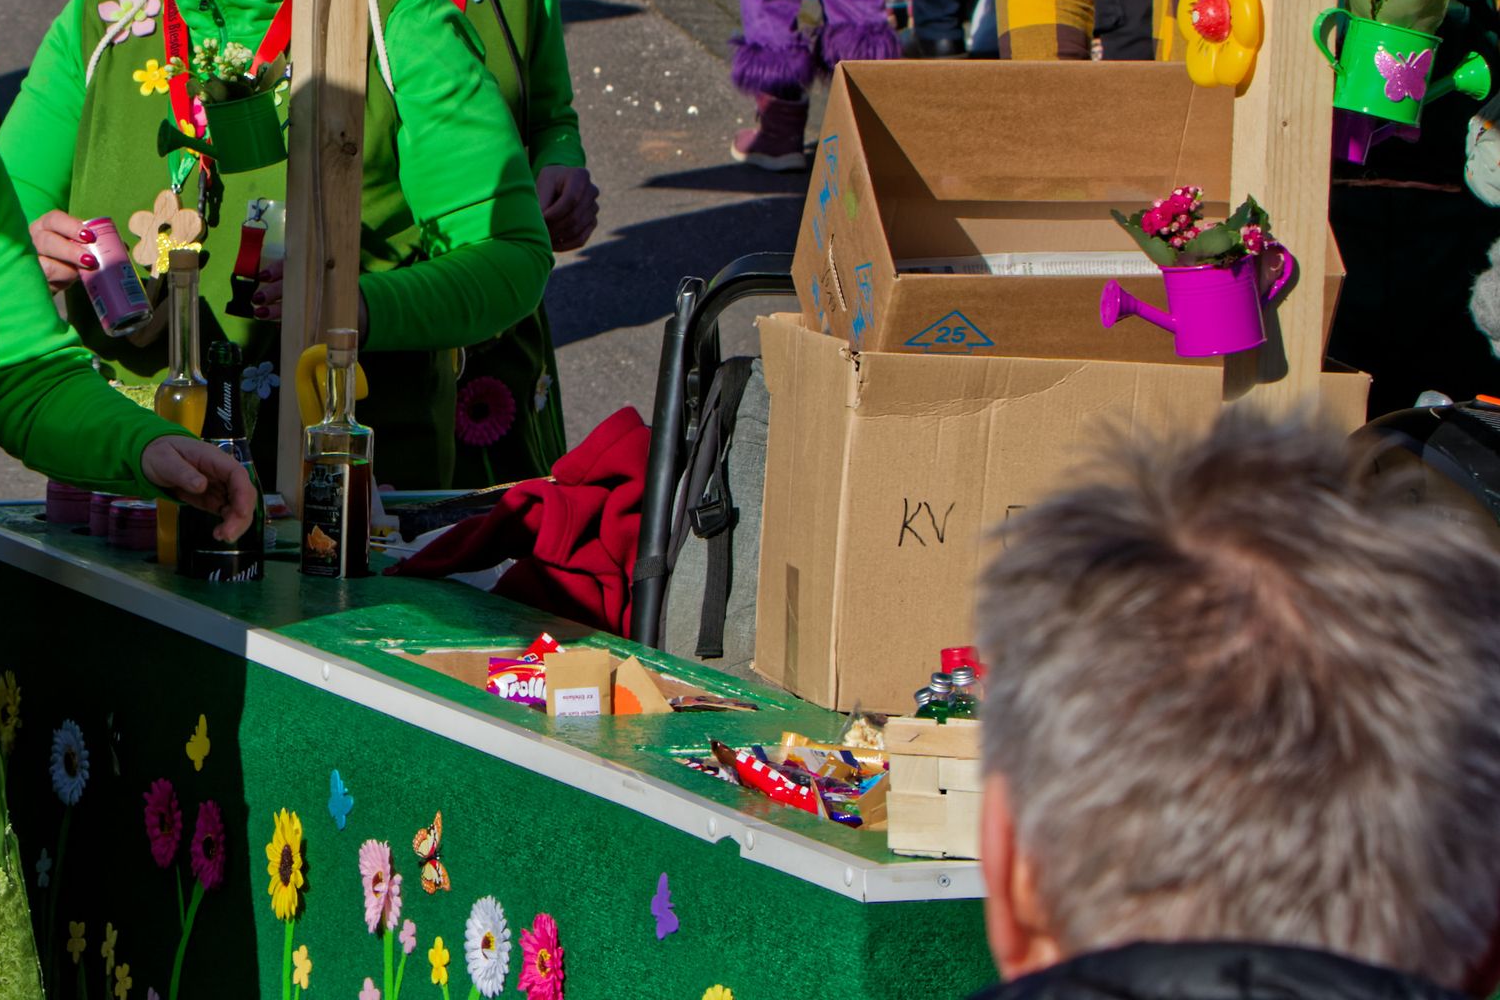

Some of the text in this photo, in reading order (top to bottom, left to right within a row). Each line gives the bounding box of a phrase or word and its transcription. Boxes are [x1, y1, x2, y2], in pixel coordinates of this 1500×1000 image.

[934, 326, 967, 344] 25
[215, 381, 233, 431] Mumm
[898, 498, 956, 547] KV
